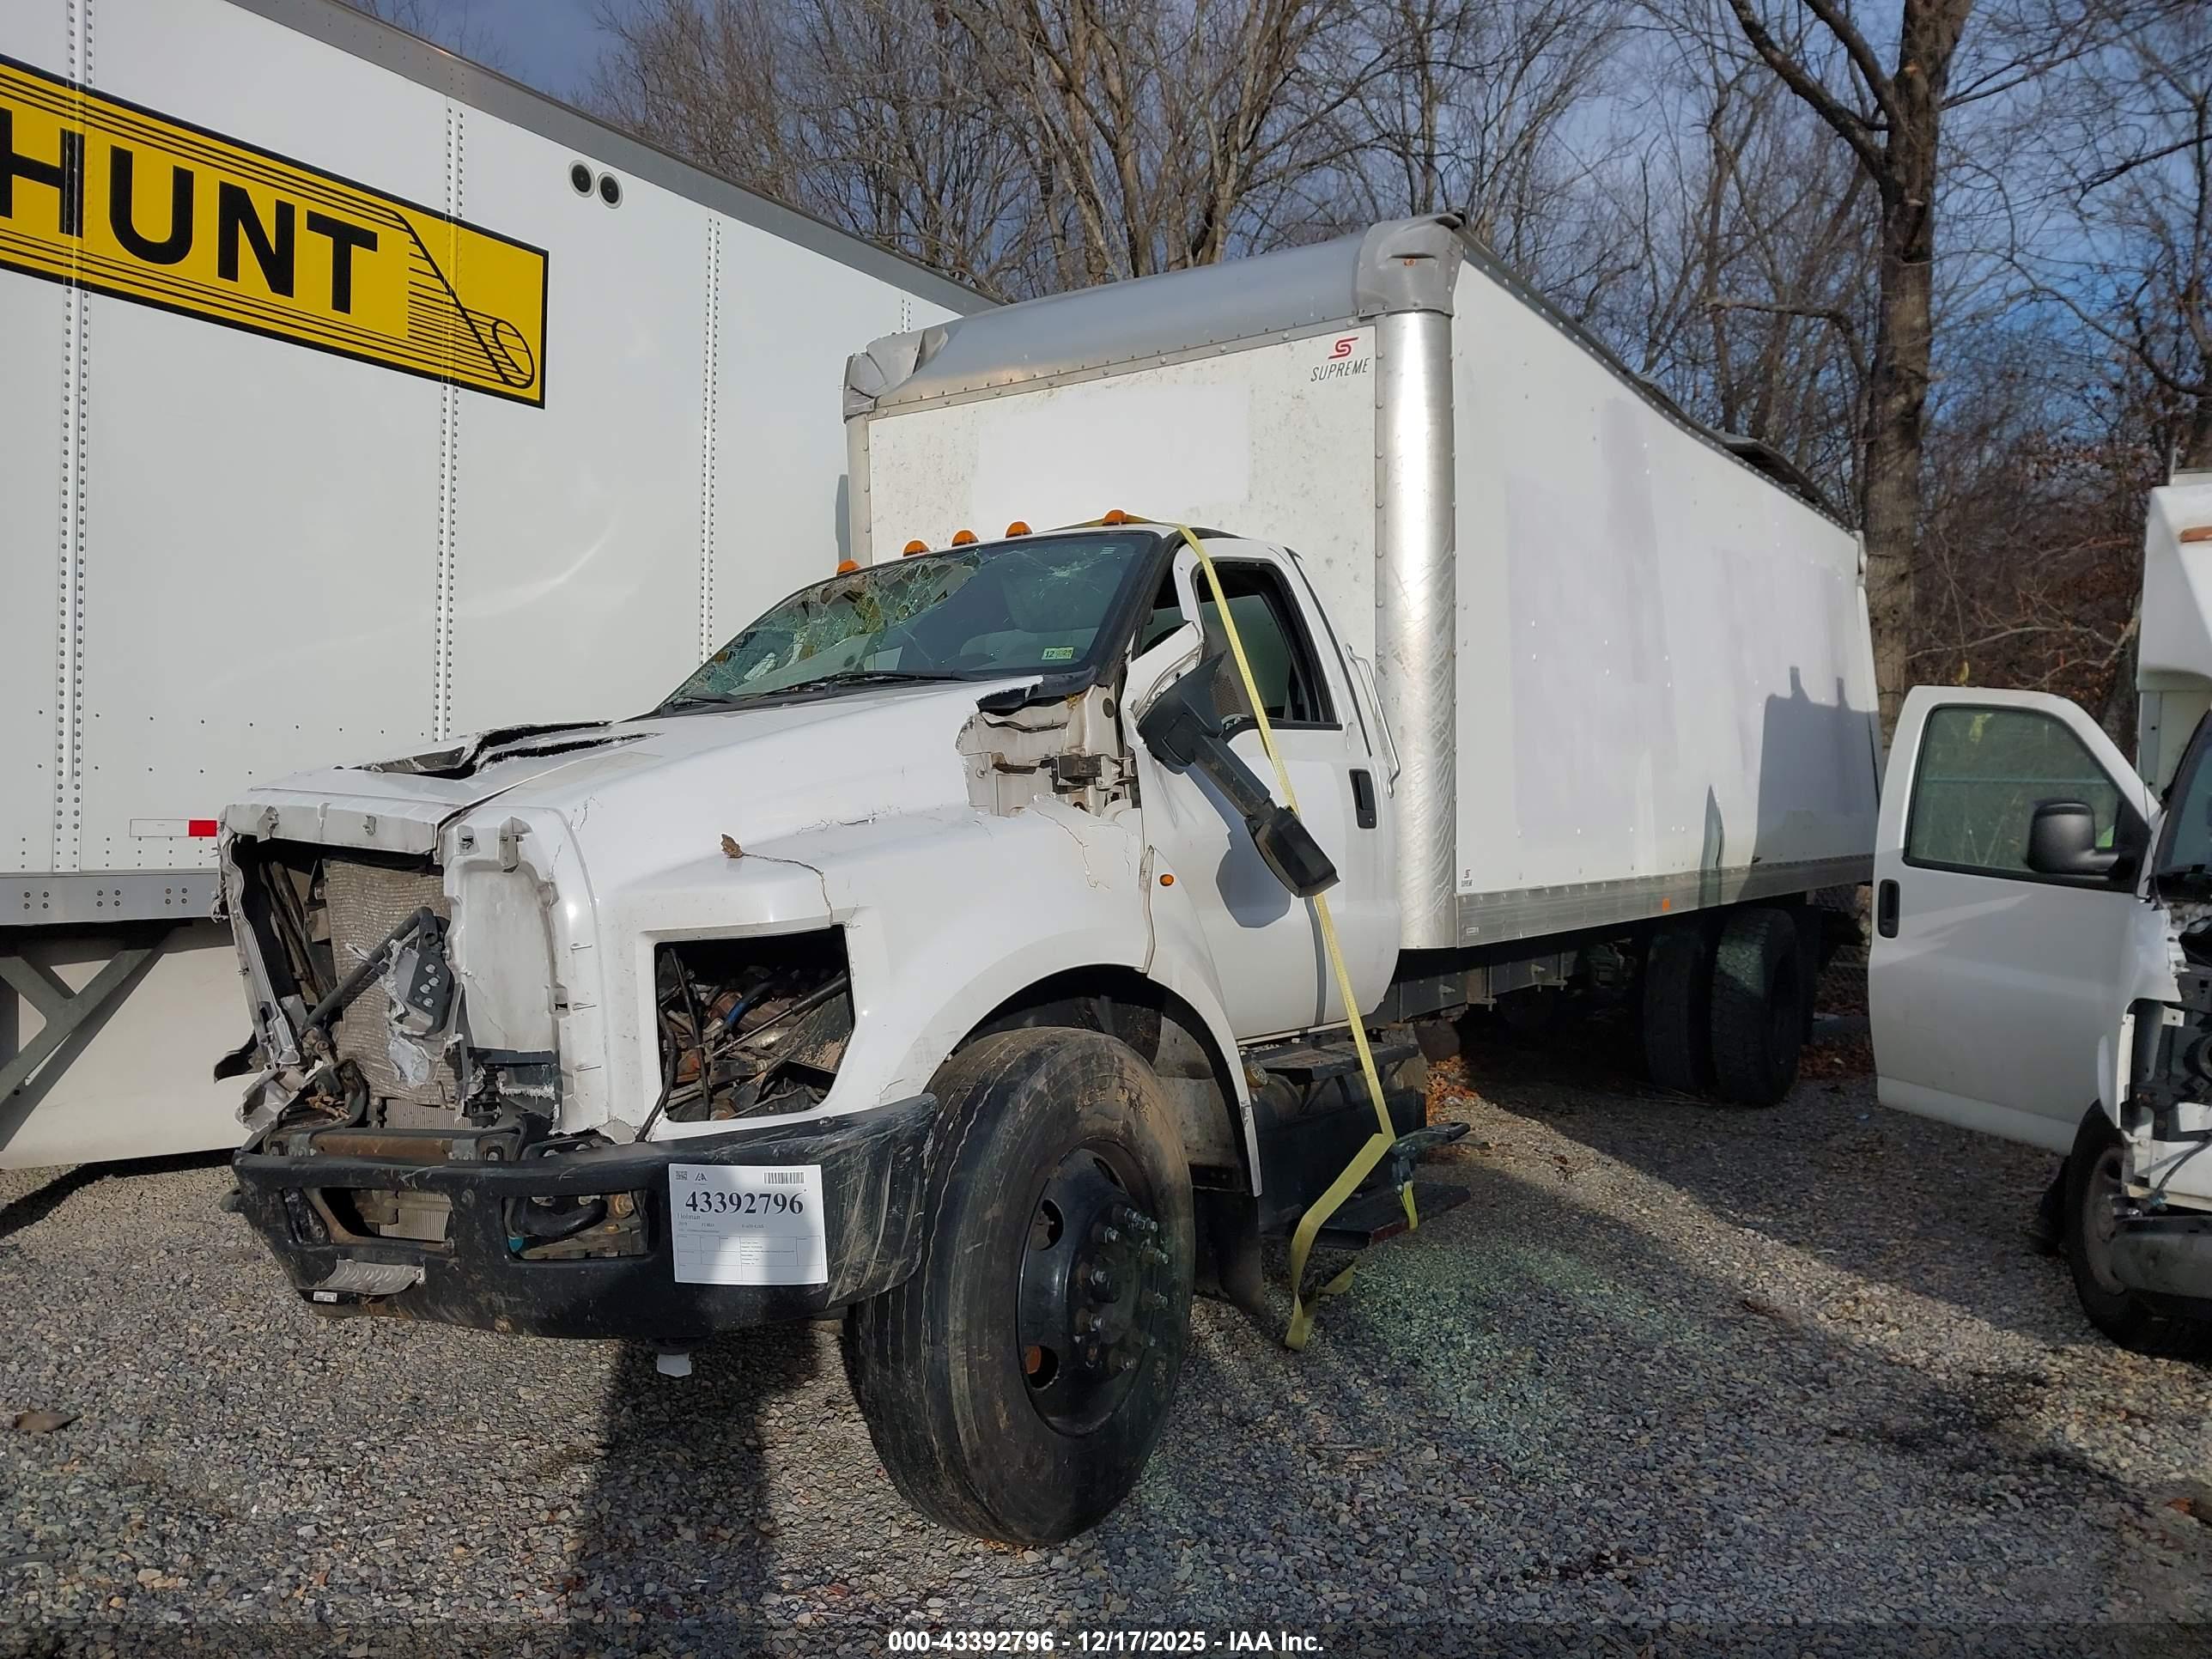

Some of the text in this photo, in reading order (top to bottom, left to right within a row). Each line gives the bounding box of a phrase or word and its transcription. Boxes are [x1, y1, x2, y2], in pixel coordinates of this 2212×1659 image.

[0, 108, 378, 315] HUNT
[1310, 357, 1370, 382] SUPREME
[685, 1191, 804, 1215] 43392796
